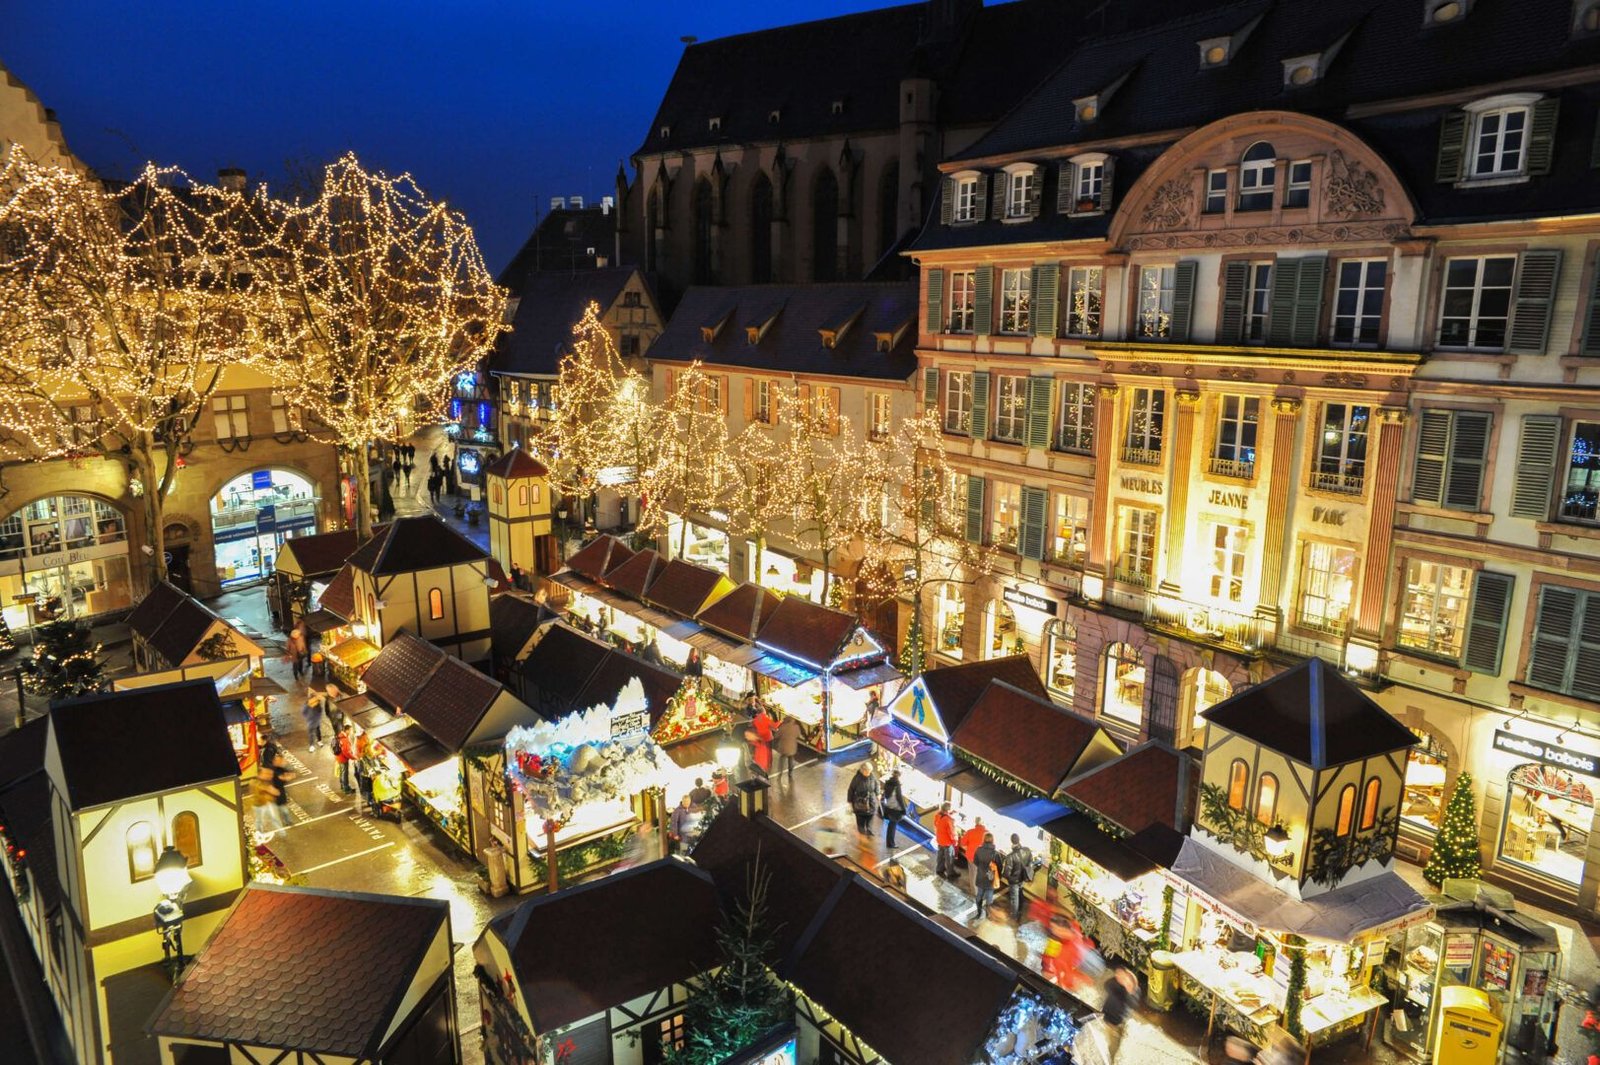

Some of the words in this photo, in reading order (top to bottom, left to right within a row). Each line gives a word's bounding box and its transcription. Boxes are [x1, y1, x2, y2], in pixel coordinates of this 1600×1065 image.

[1120, 475, 1163, 495] MEUBLES
[1208, 490, 1249, 510] JEANNE
[1311, 505, 1345, 527] D'ARC
[1544, 747, 1595, 771] bobois
[349, 814, 385, 840] PAYANT
